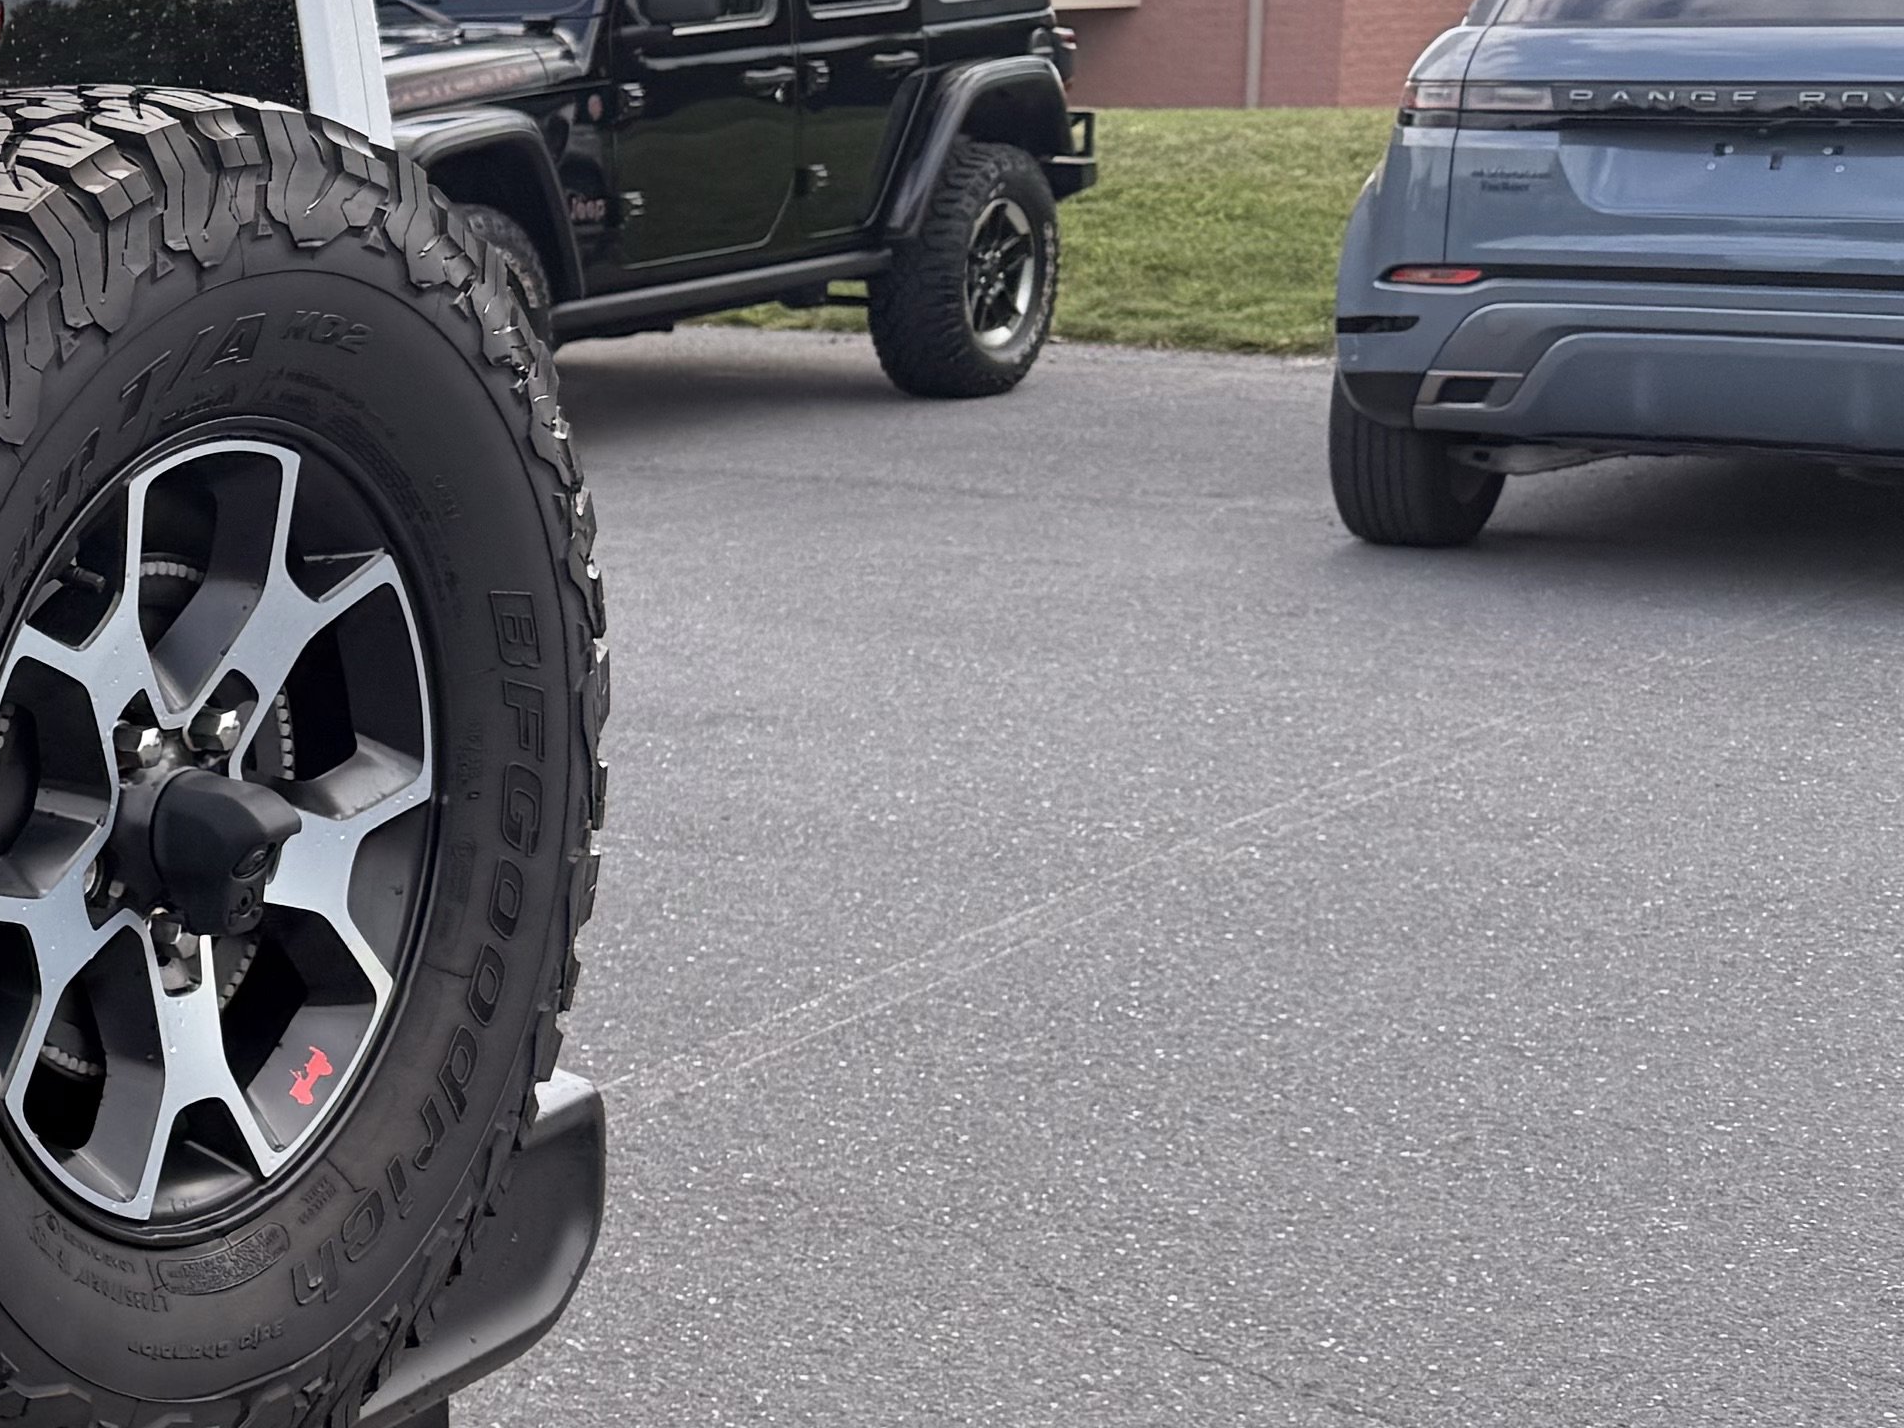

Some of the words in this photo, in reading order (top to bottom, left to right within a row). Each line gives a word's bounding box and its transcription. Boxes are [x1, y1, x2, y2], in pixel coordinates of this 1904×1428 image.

[1568, 89, 1759, 107] RANGE
[280, 309, 375, 355] KO2
[292, 589, 546, 1306] BFGoodrich
